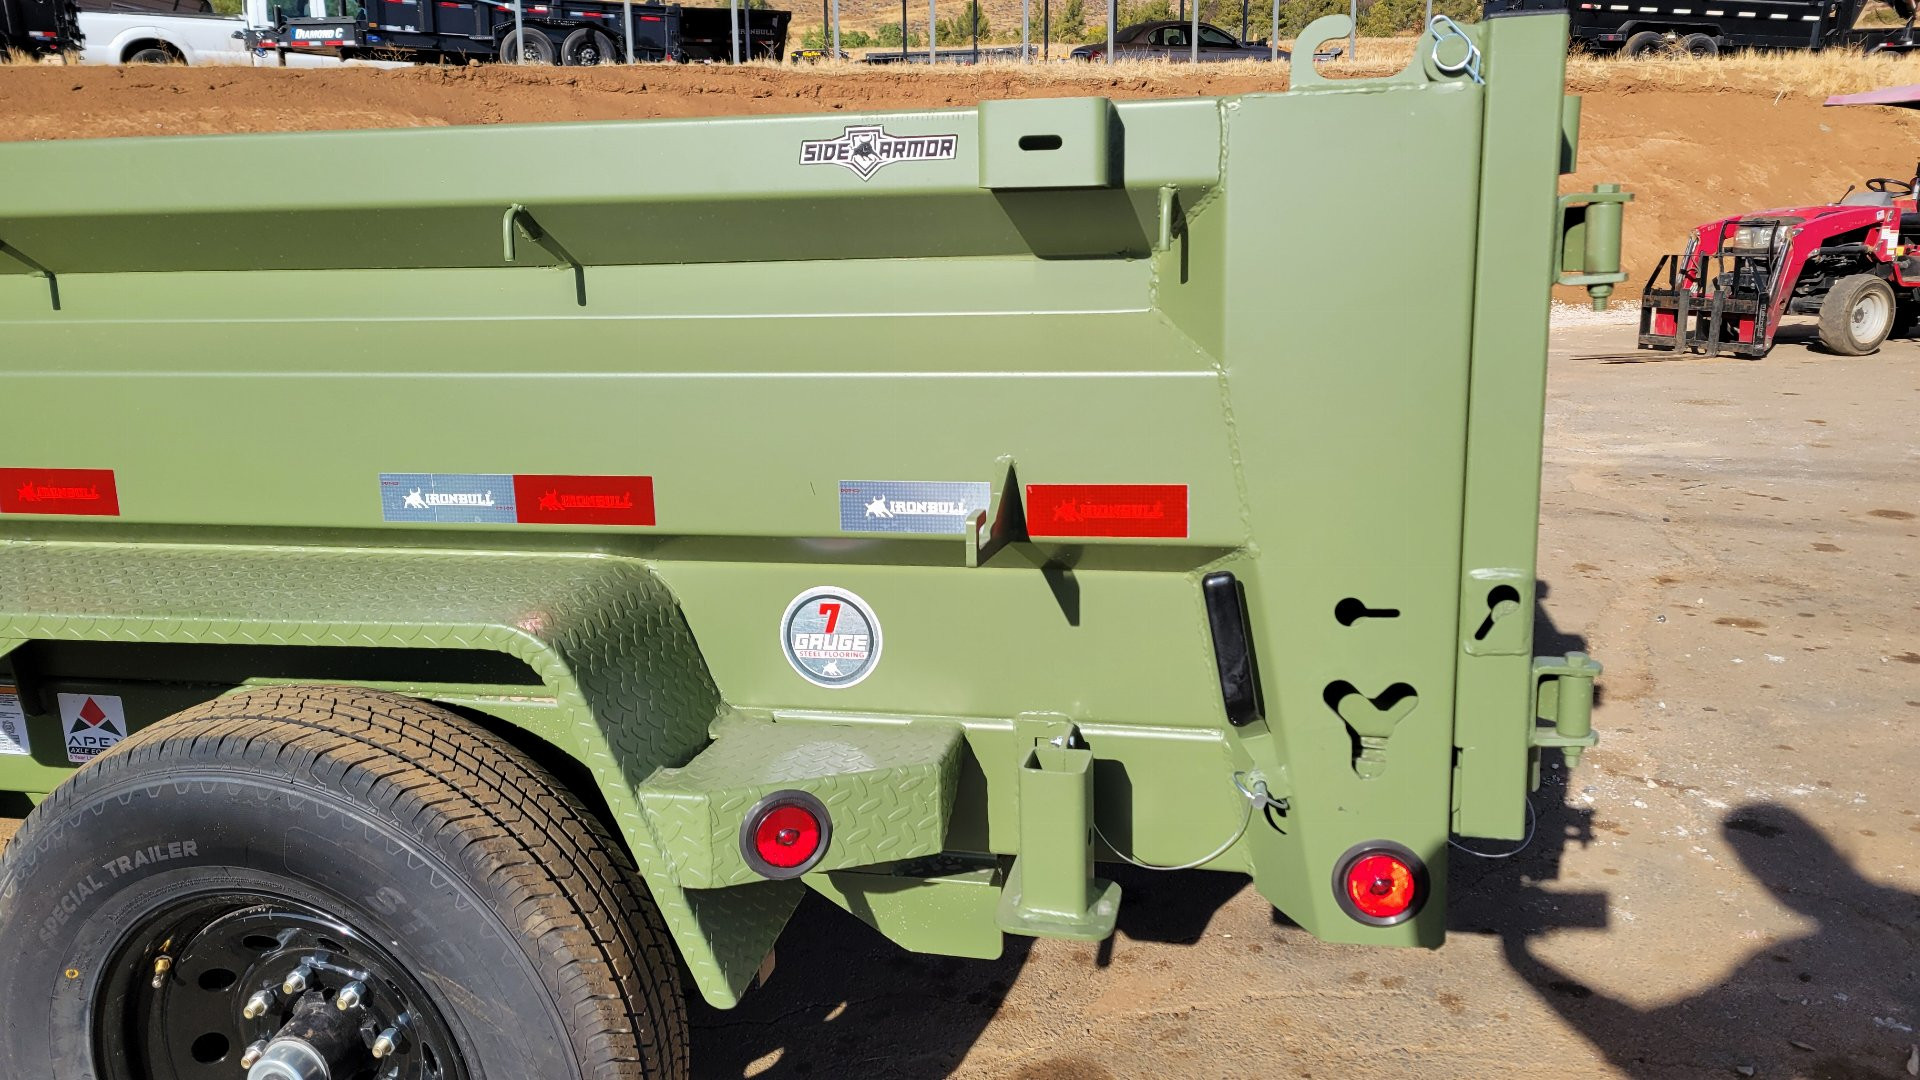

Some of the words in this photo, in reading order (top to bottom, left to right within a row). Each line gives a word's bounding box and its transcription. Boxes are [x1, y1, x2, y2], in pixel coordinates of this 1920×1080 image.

[335, 27, 344, 39] C
[804, 143, 850, 161] SIDE
[879, 139, 953, 158] ARMOR
[424, 490, 494, 507] IRONBULL
[889, 498, 968, 515] IRONBULL
[819, 603, 841, 634] 7
[795, 633, 869, 652] GAUGE
[38, 874, 103, 944] SPECIAL
[101, 840, 199, 879] TRAILER
